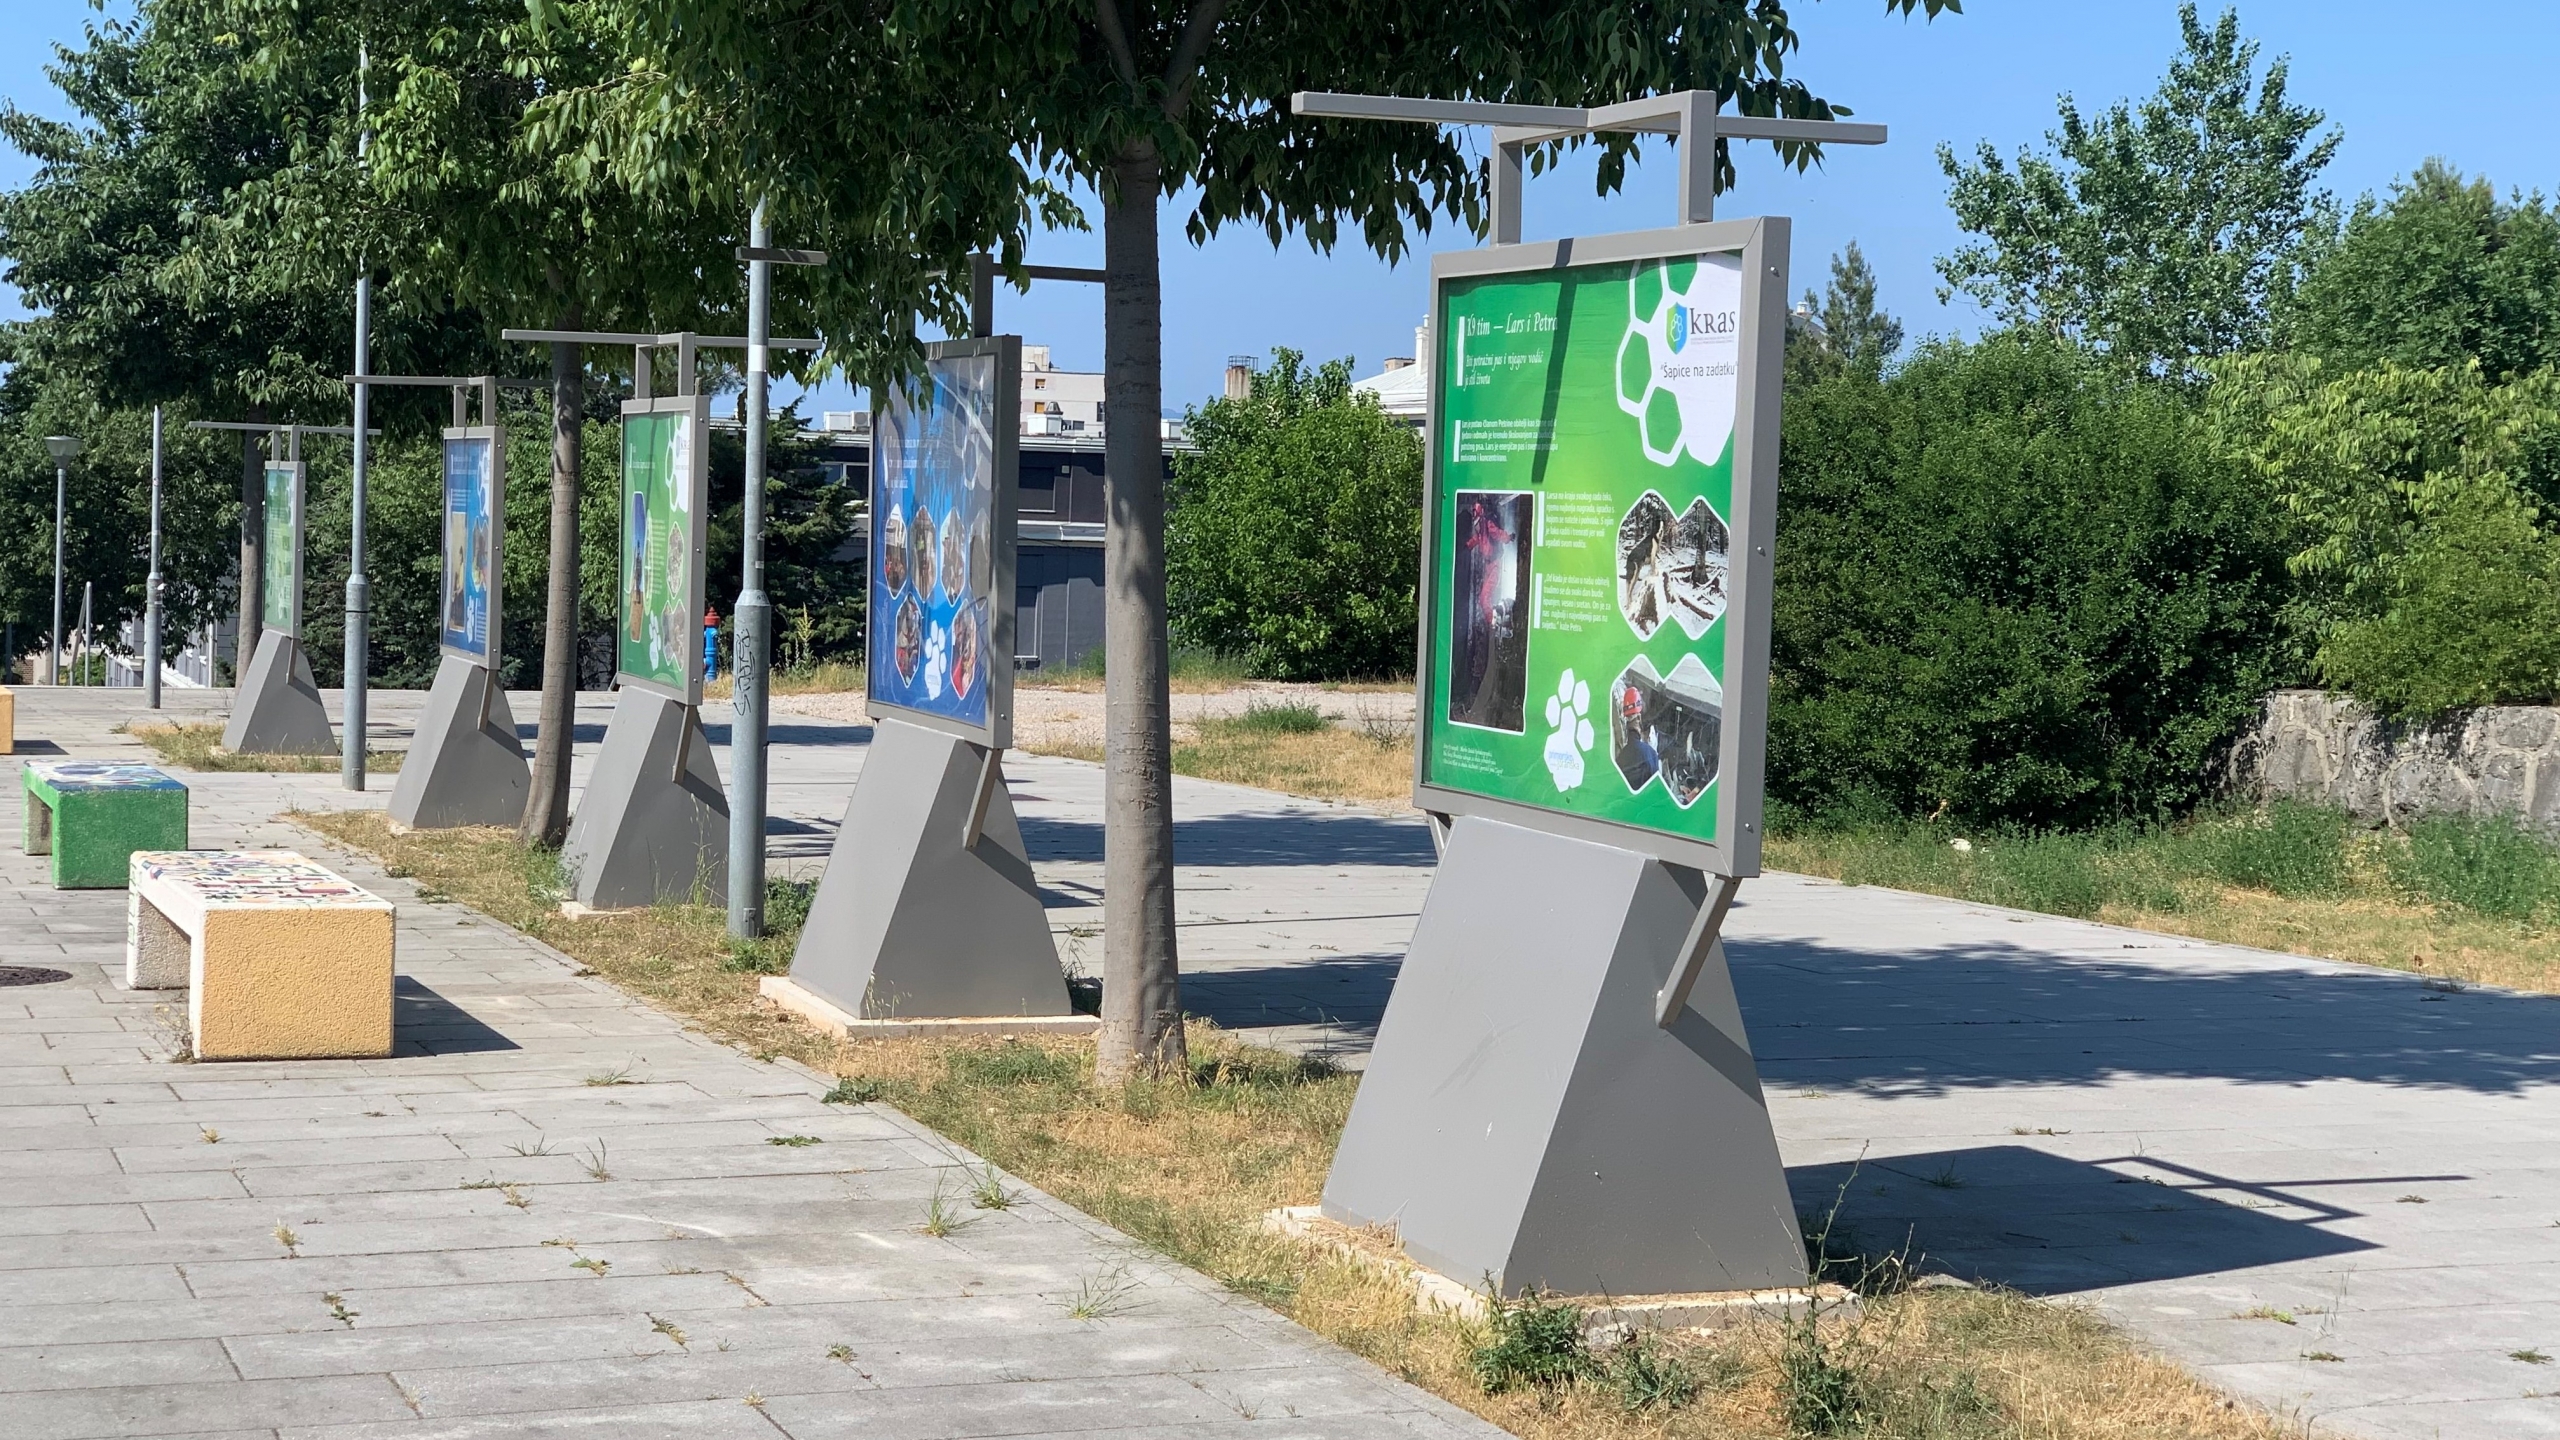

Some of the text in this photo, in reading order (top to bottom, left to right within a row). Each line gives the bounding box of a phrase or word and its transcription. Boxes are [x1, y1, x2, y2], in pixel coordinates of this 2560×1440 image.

[1467, 314, 1476, 336] K9
[1477, 318, 1490, 335] tim
[1505, 313, 1524, 333] Lars
[1527, 314, 1531, 332] i
[1534, 312, 1558, 331] Petra
[1492, 354, 1502, 371] pas
[1508, 353, 1526, 370] njegov
[1694, 367, 1703, 376] na
